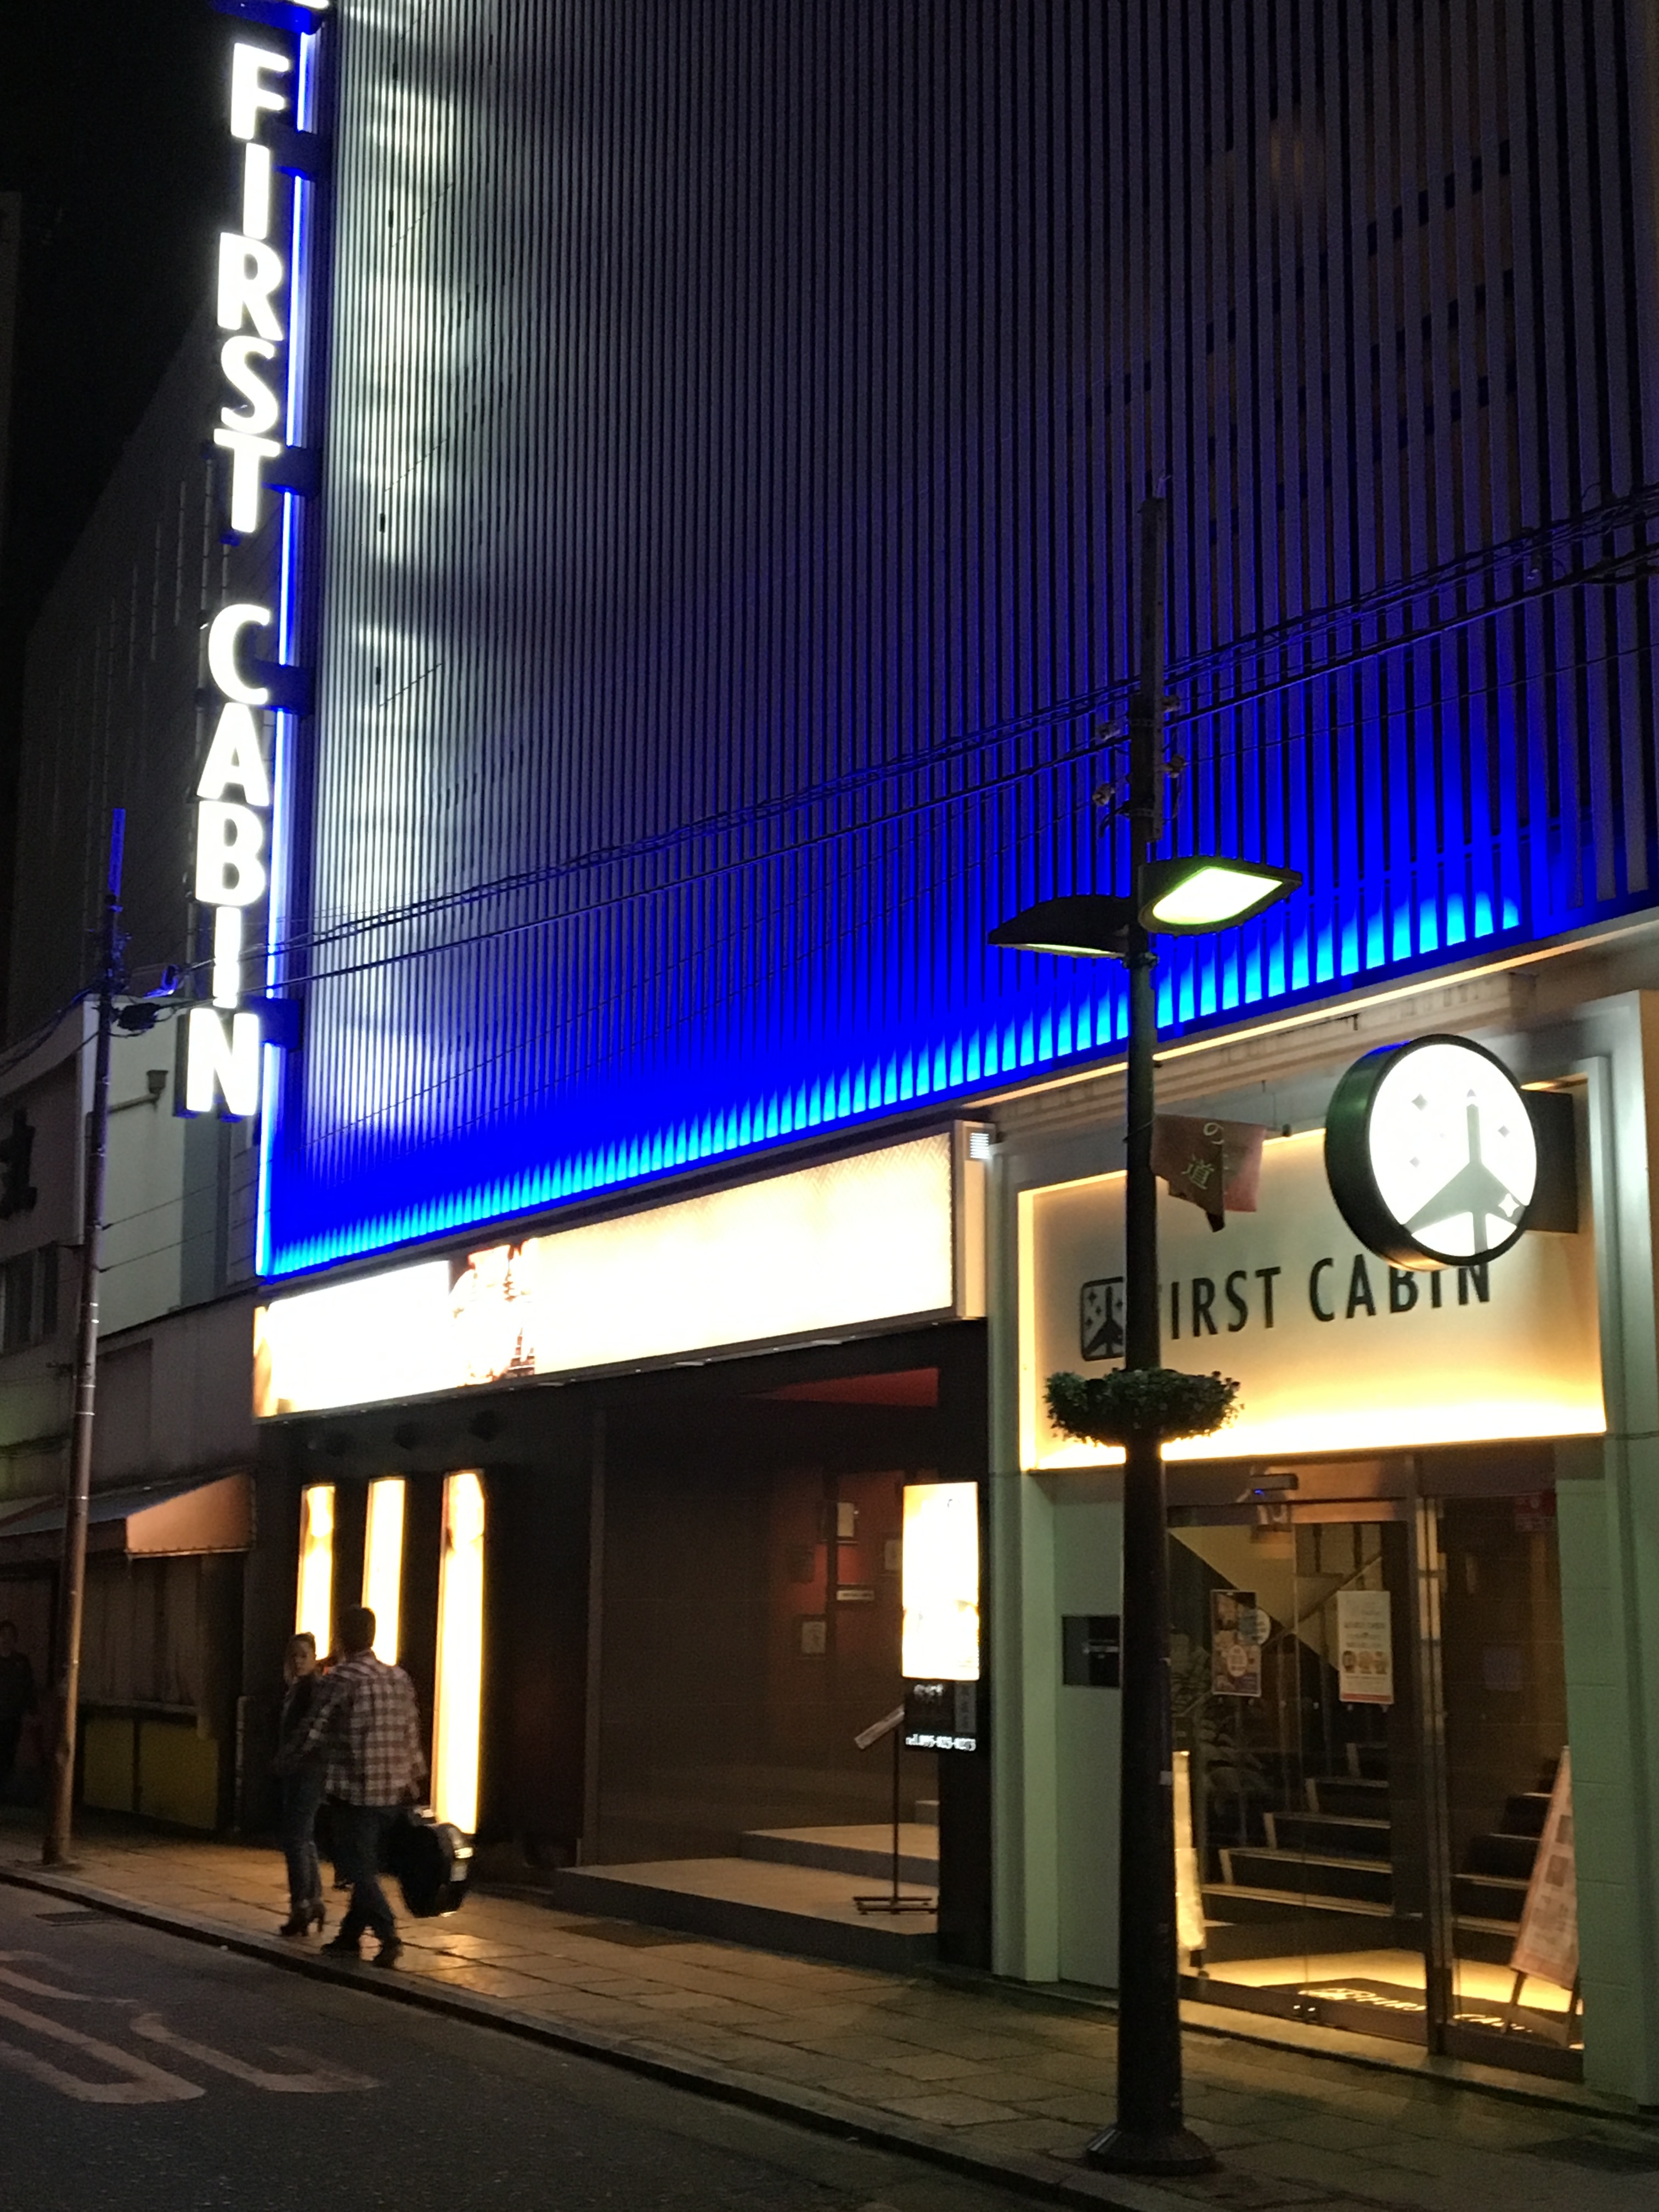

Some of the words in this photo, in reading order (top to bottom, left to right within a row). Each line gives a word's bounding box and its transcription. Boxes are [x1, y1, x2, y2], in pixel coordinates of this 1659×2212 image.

[213, 42, 290, 533] FIRST
[187, 603, 271, 1116] CABIN
[1159, 1266, 1281, 1340] IRST
[1309, 1254, 1490, 1322] CABIN
